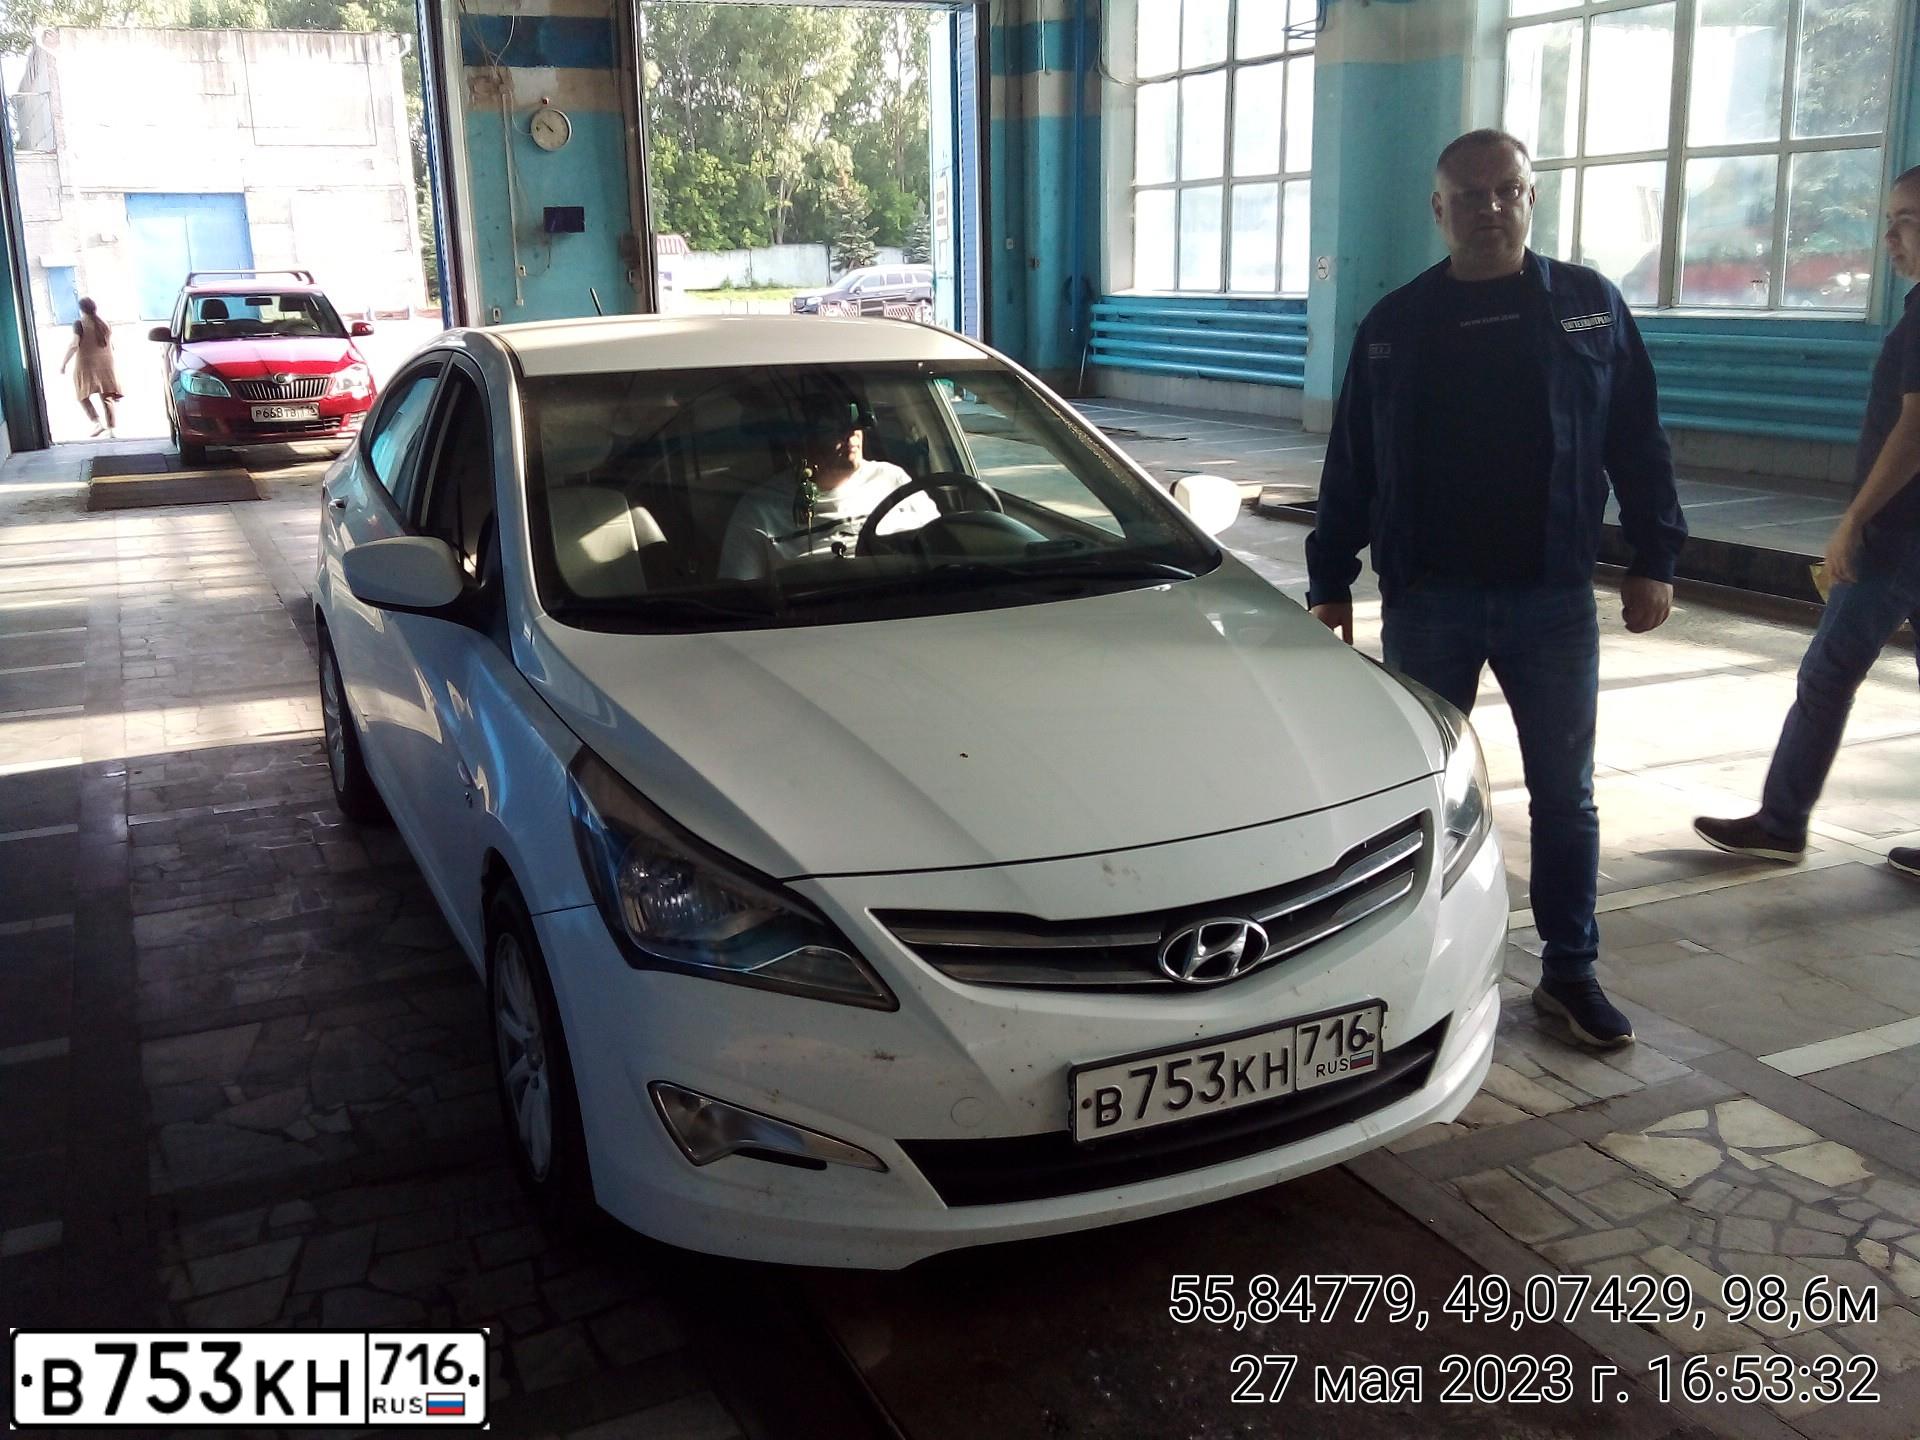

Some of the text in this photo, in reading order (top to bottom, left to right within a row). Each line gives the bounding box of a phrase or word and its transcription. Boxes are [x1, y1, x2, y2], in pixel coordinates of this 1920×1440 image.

[1096, 1014, 1367, 1129] В753КН 716
[1316, 1057, 1349, 1078] RUS
